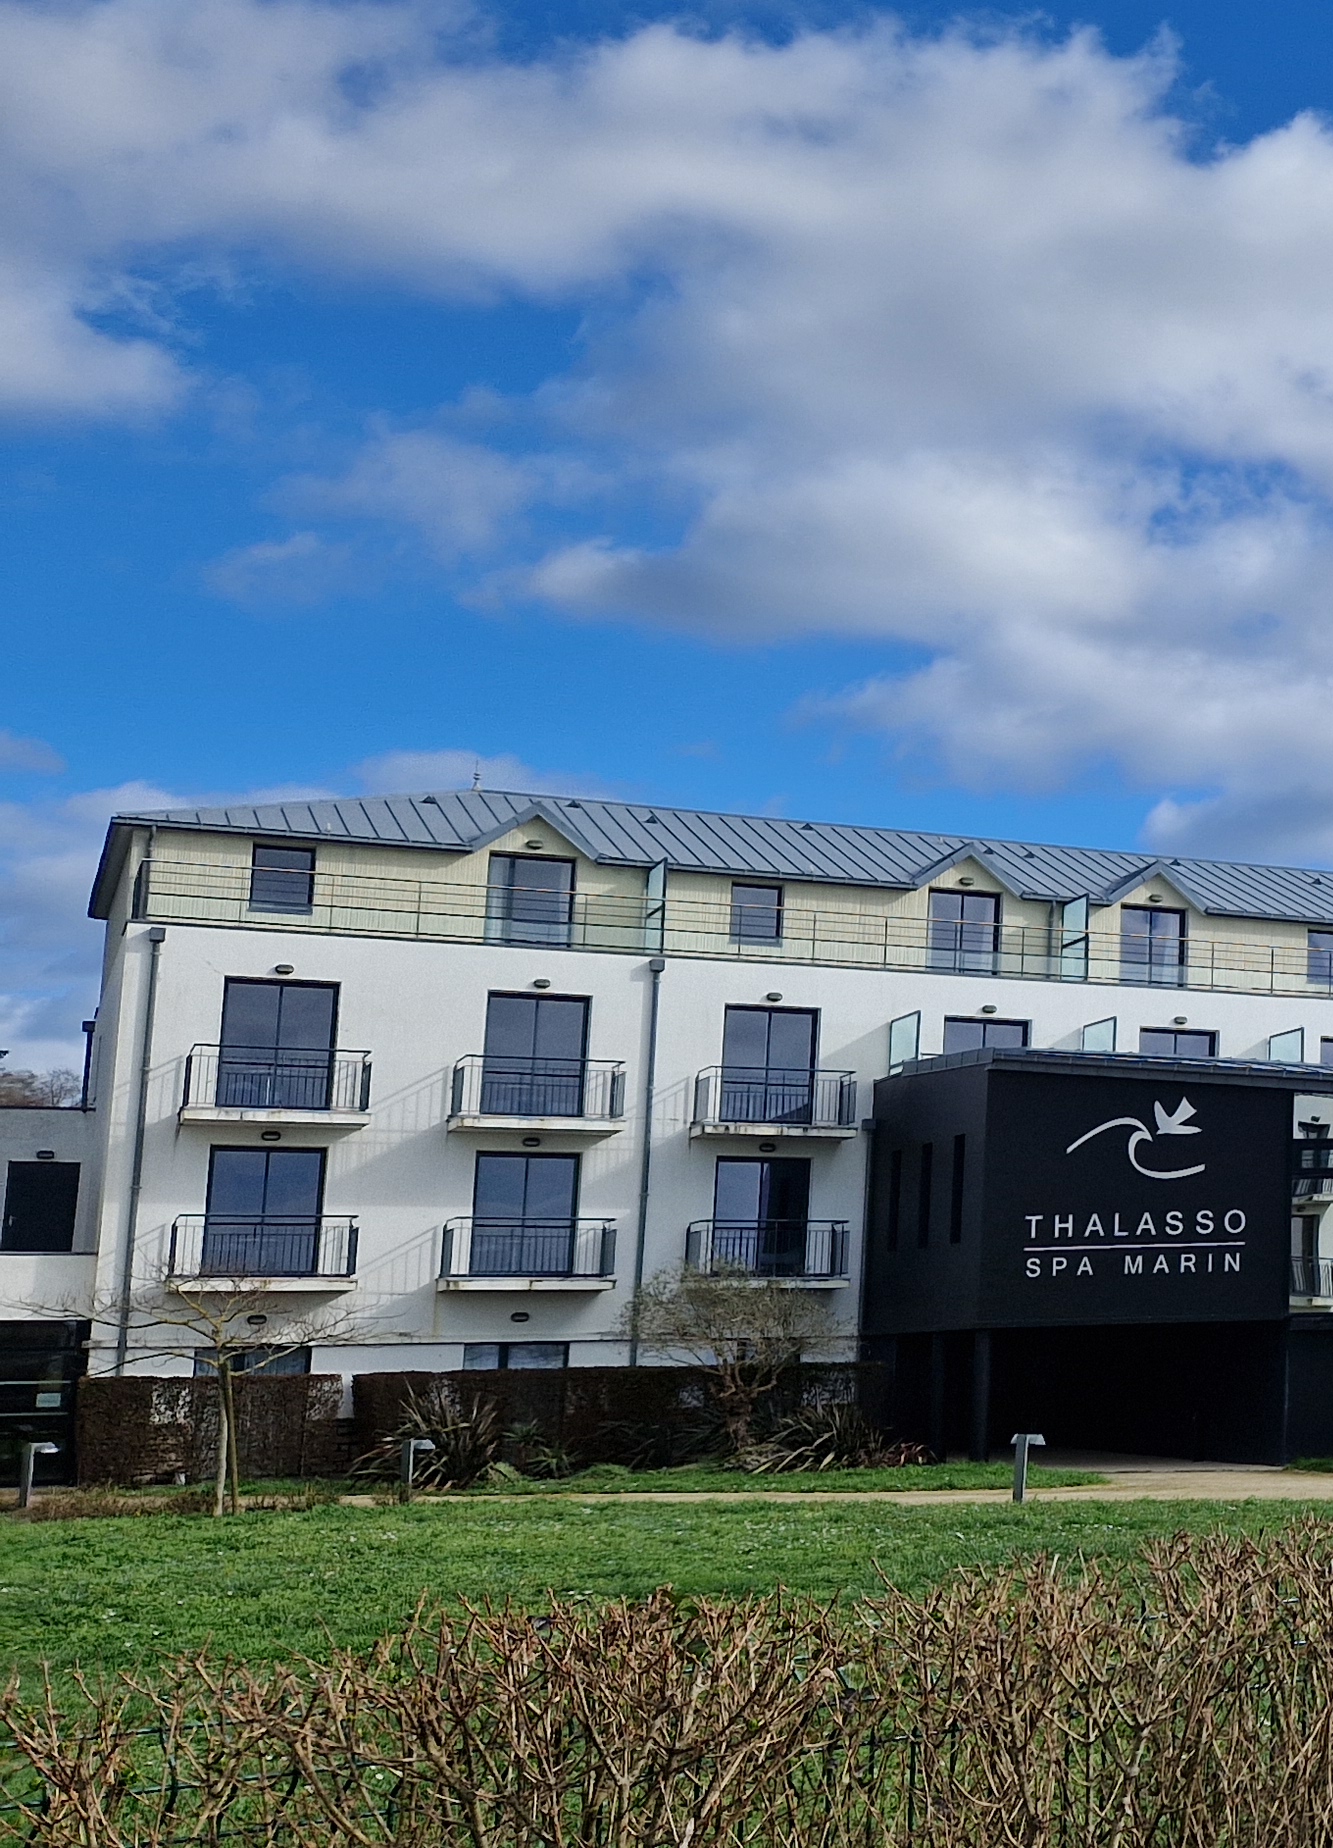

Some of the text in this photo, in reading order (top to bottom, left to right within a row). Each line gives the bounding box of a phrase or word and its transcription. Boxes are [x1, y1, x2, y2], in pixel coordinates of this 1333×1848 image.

[1024, 1209, 1246, 1239] THALASSO
[1025, 1253, 1241, 1278] SPA MARIN
